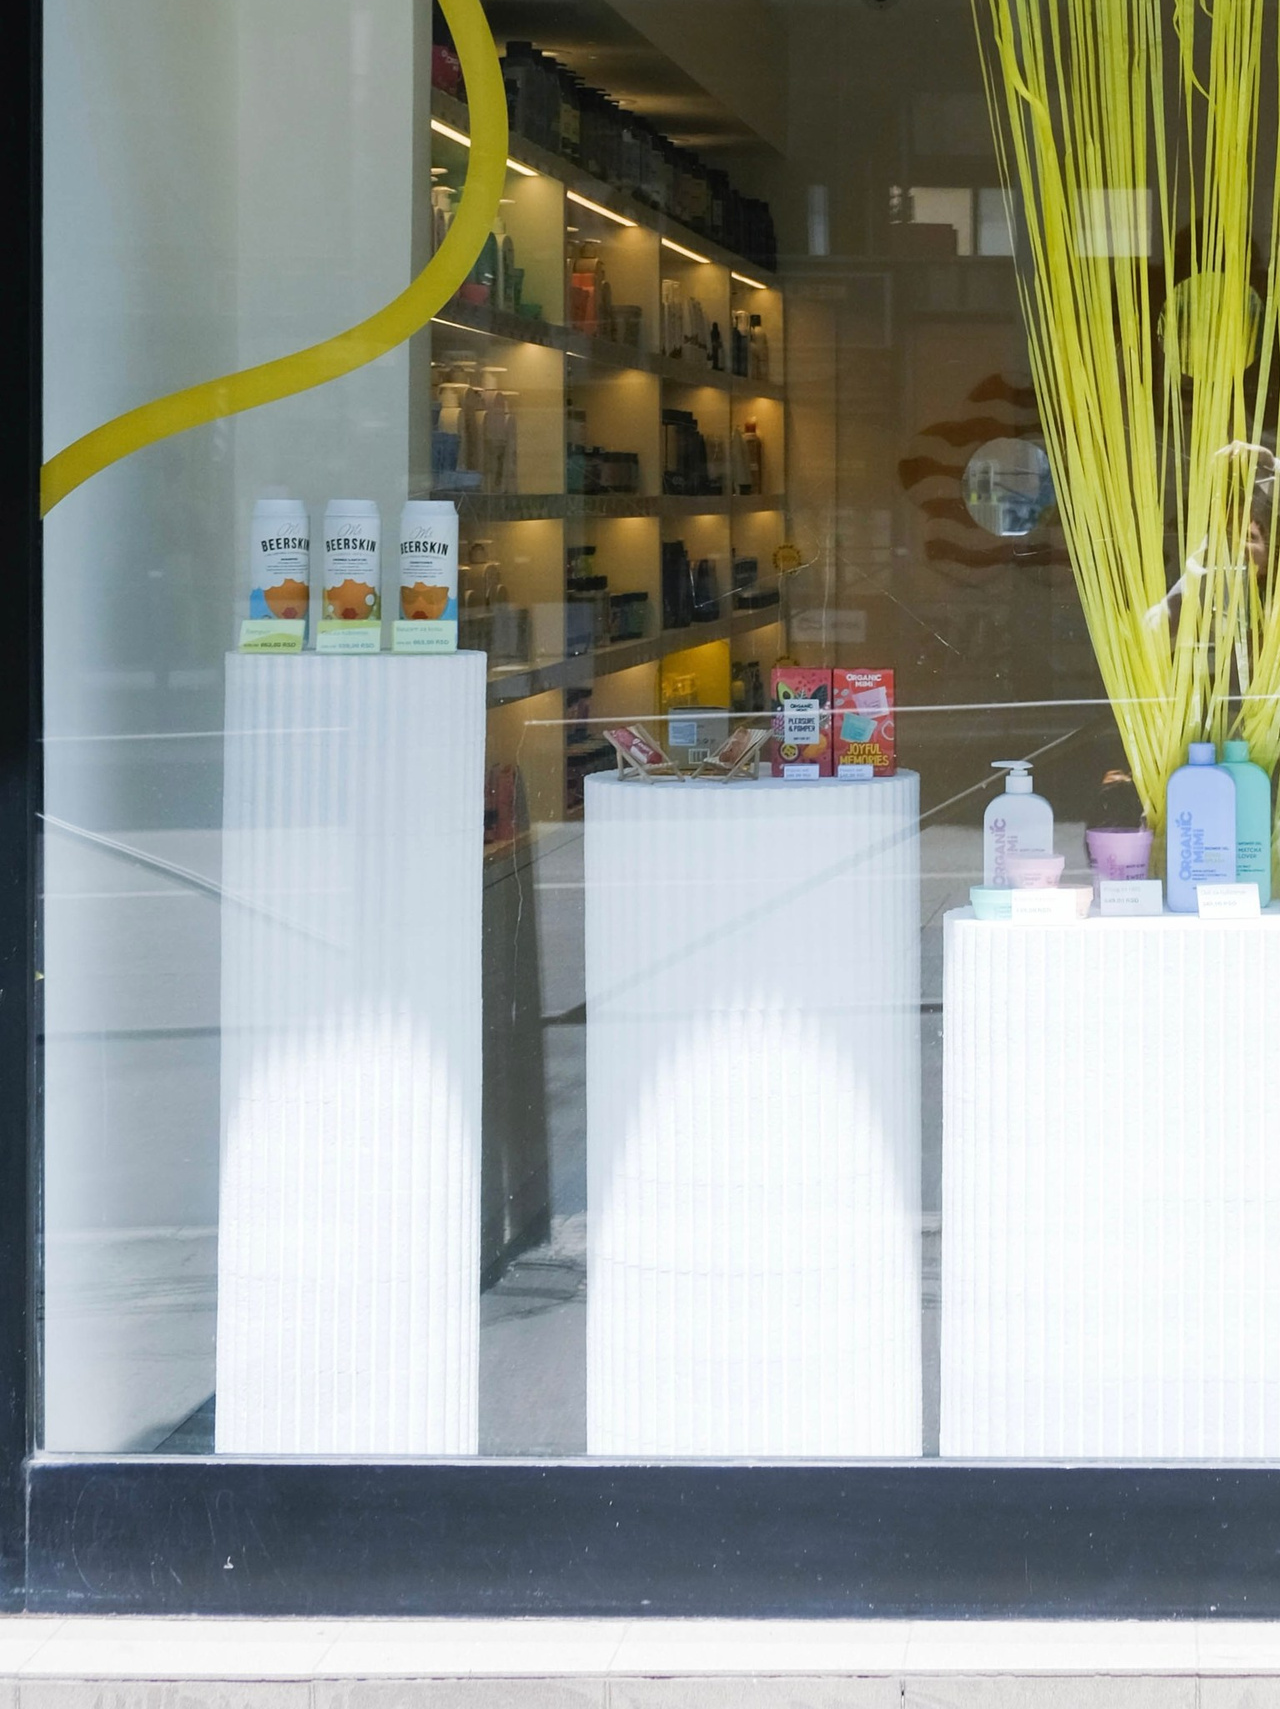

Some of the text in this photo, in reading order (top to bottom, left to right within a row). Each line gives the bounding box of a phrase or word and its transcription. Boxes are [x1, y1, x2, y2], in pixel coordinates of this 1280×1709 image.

[326, 537, 377, 553] BEERSKIN
[788, 717, 816, 725] PLEASURE
[848, 743, 882, 754] JOYFUL
[840, 755, 890, 766] MEMORIES
[1175, 810, 1193, 881] ORGANIC
